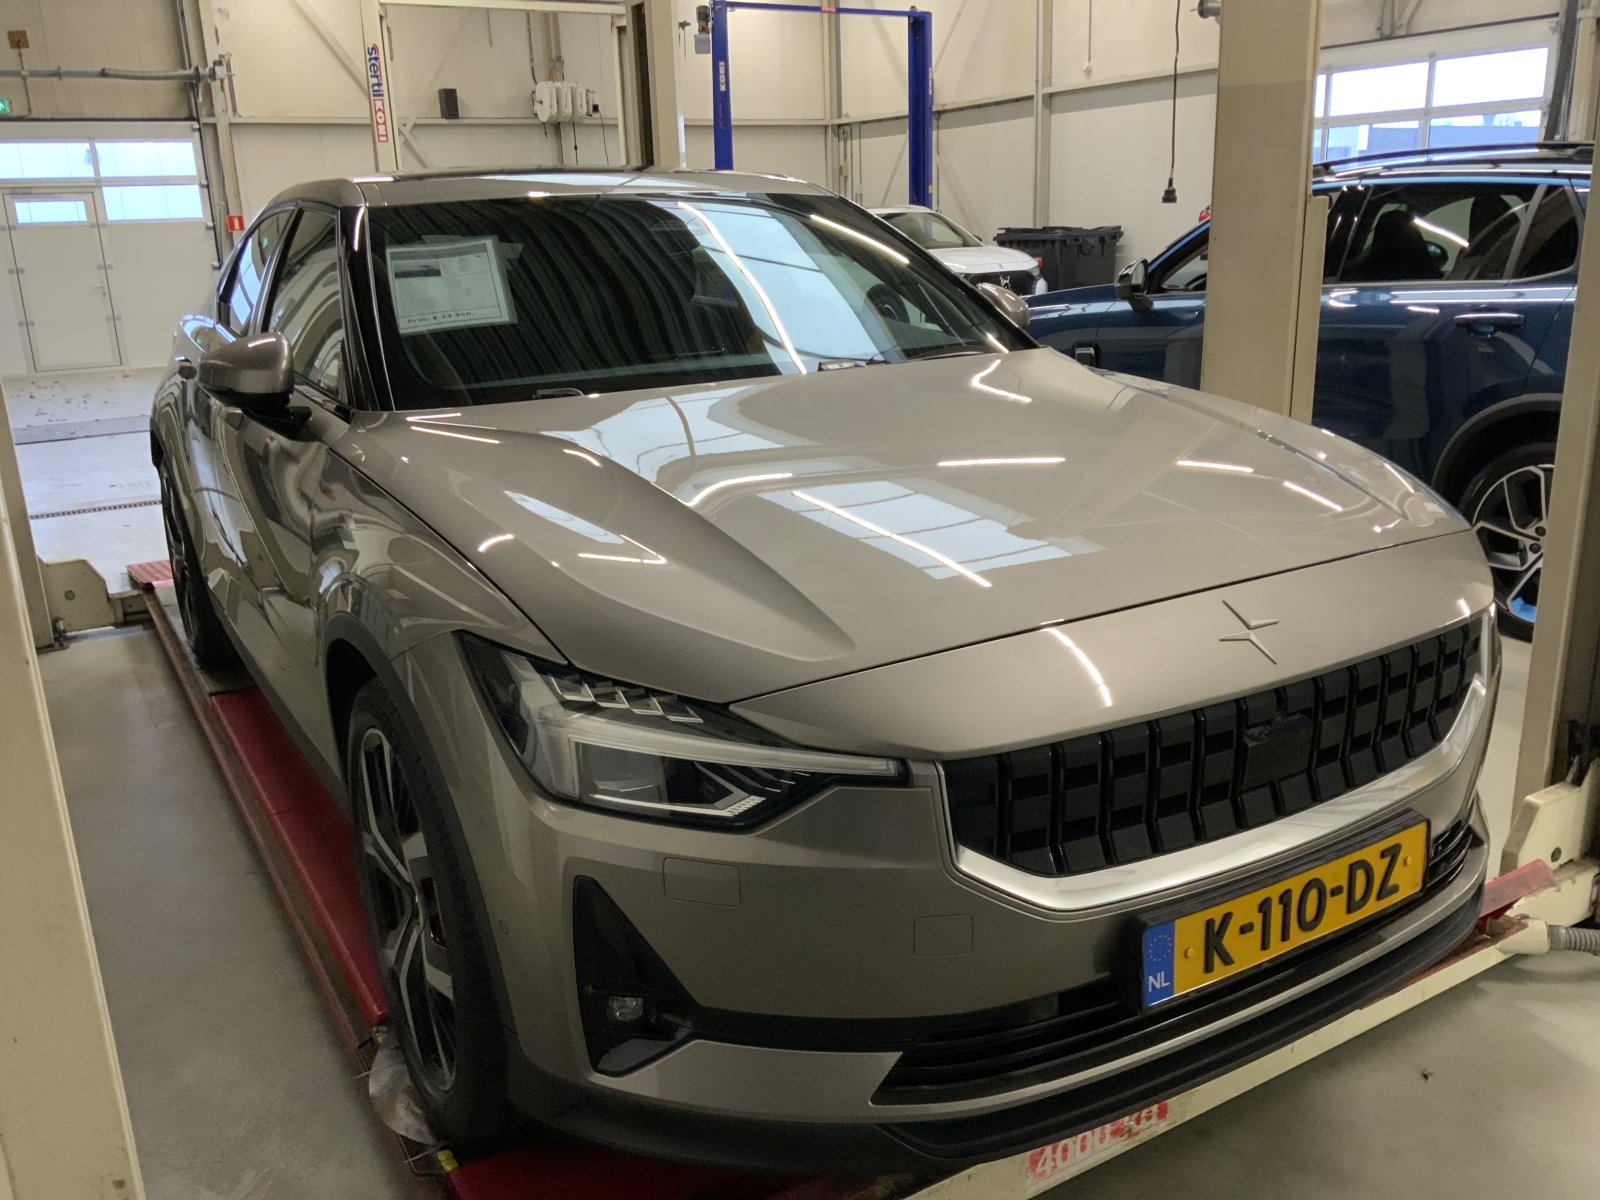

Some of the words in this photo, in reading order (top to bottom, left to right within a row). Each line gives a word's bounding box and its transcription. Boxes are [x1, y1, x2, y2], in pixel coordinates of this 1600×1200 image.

[367, 45, 384, 98] stertil
[373, 99, 389, 142] KONI
[1203, 843, 1402, 974] K-110-DZ
[1148, 971, 1171, 992] NL
